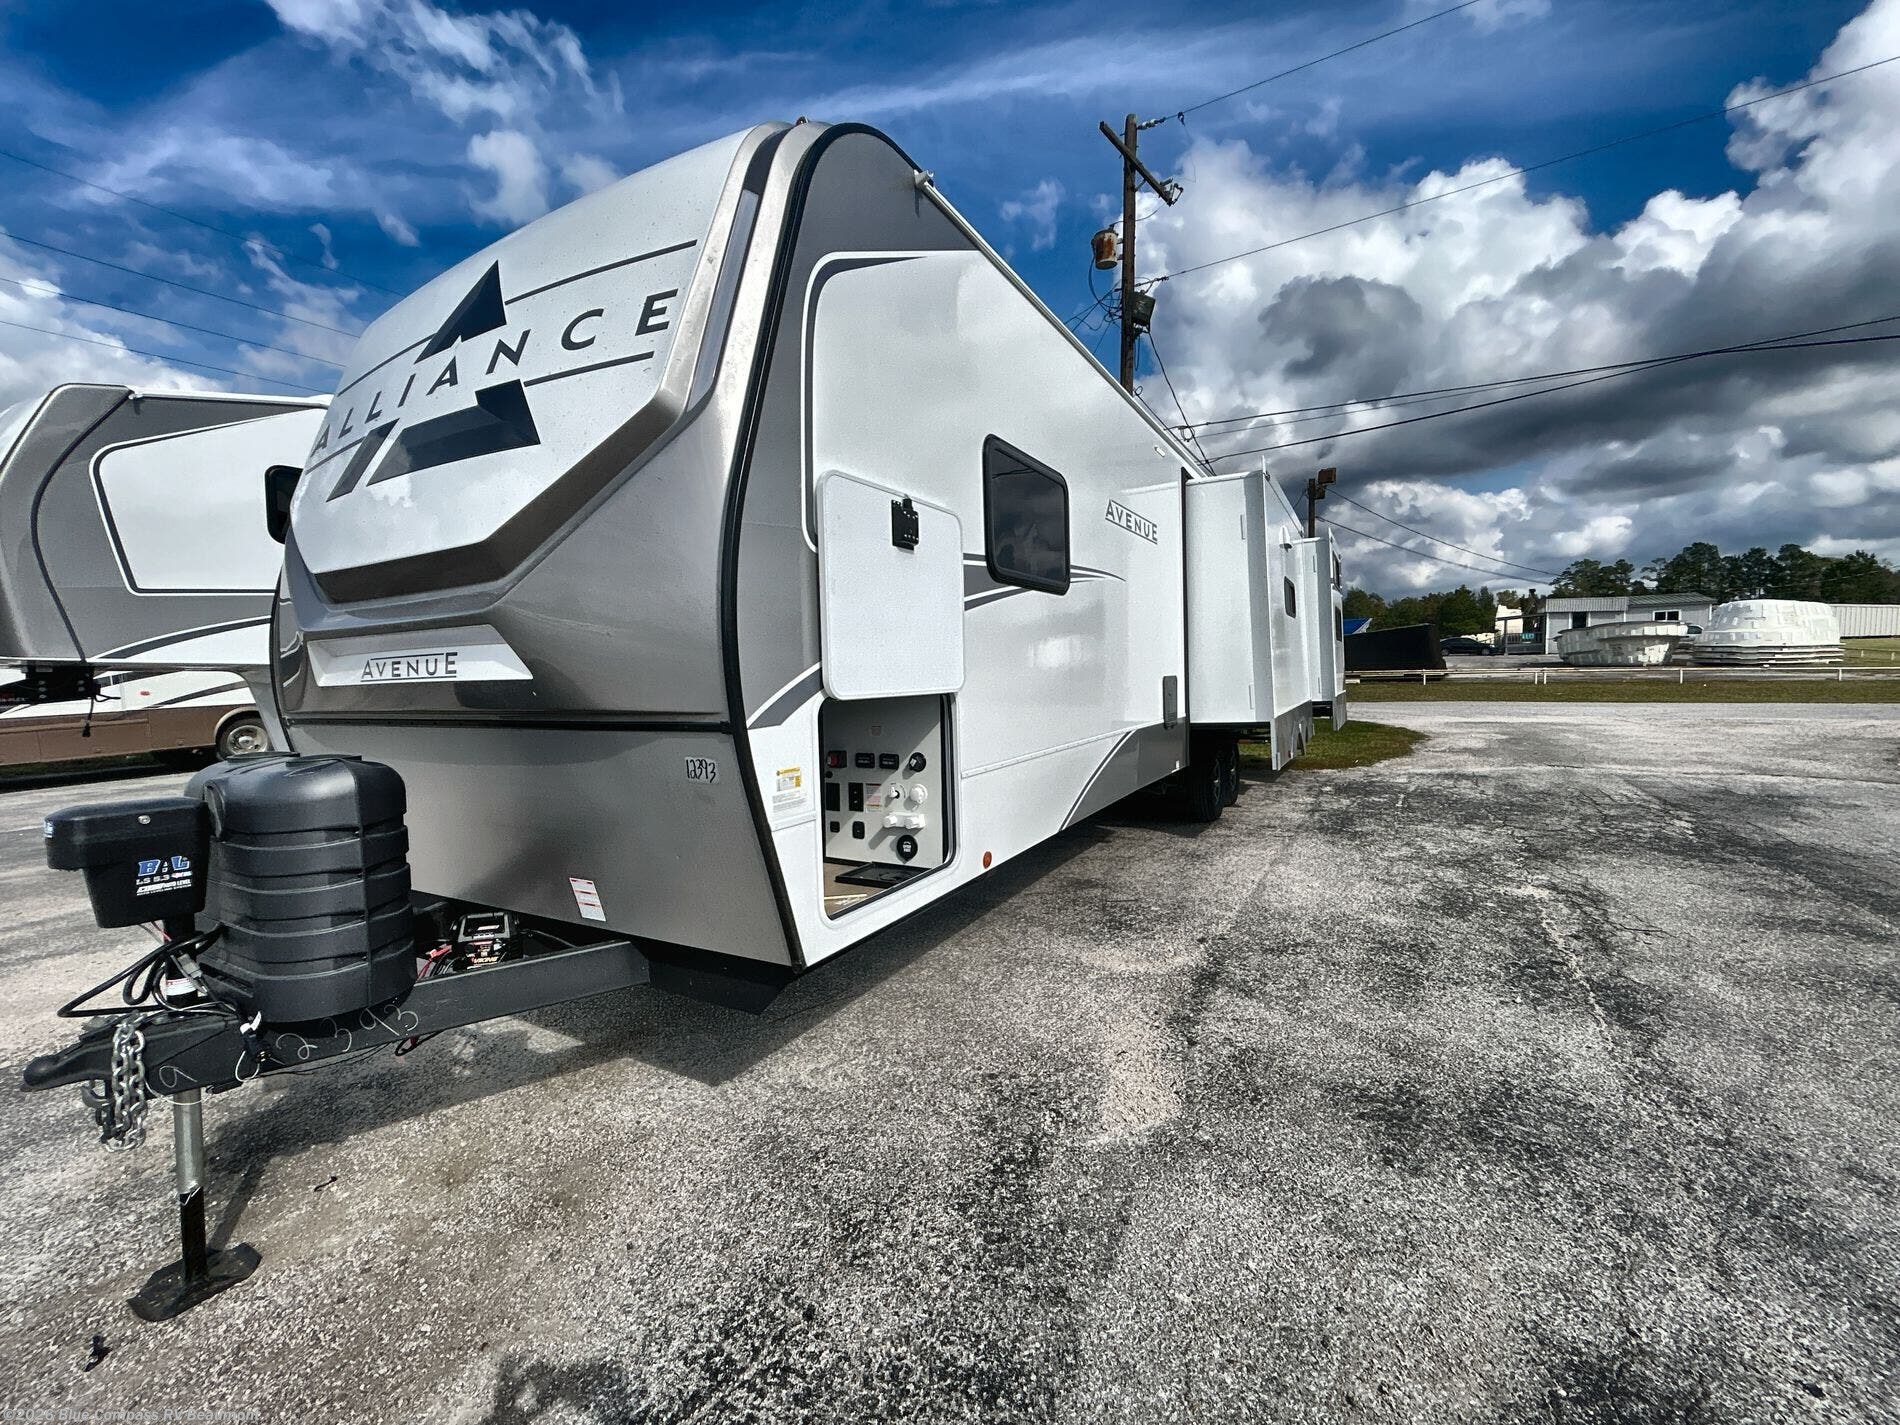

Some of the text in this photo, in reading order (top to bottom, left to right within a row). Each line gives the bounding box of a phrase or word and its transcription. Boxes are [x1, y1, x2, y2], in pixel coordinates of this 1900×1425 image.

[311, 288, 678, 460] ALLIANCE
[1105, 499, 1158, 543] AVENUE
[361, 652, 458, 679] AVENUE
[686, 759, 717, 783] 12393
